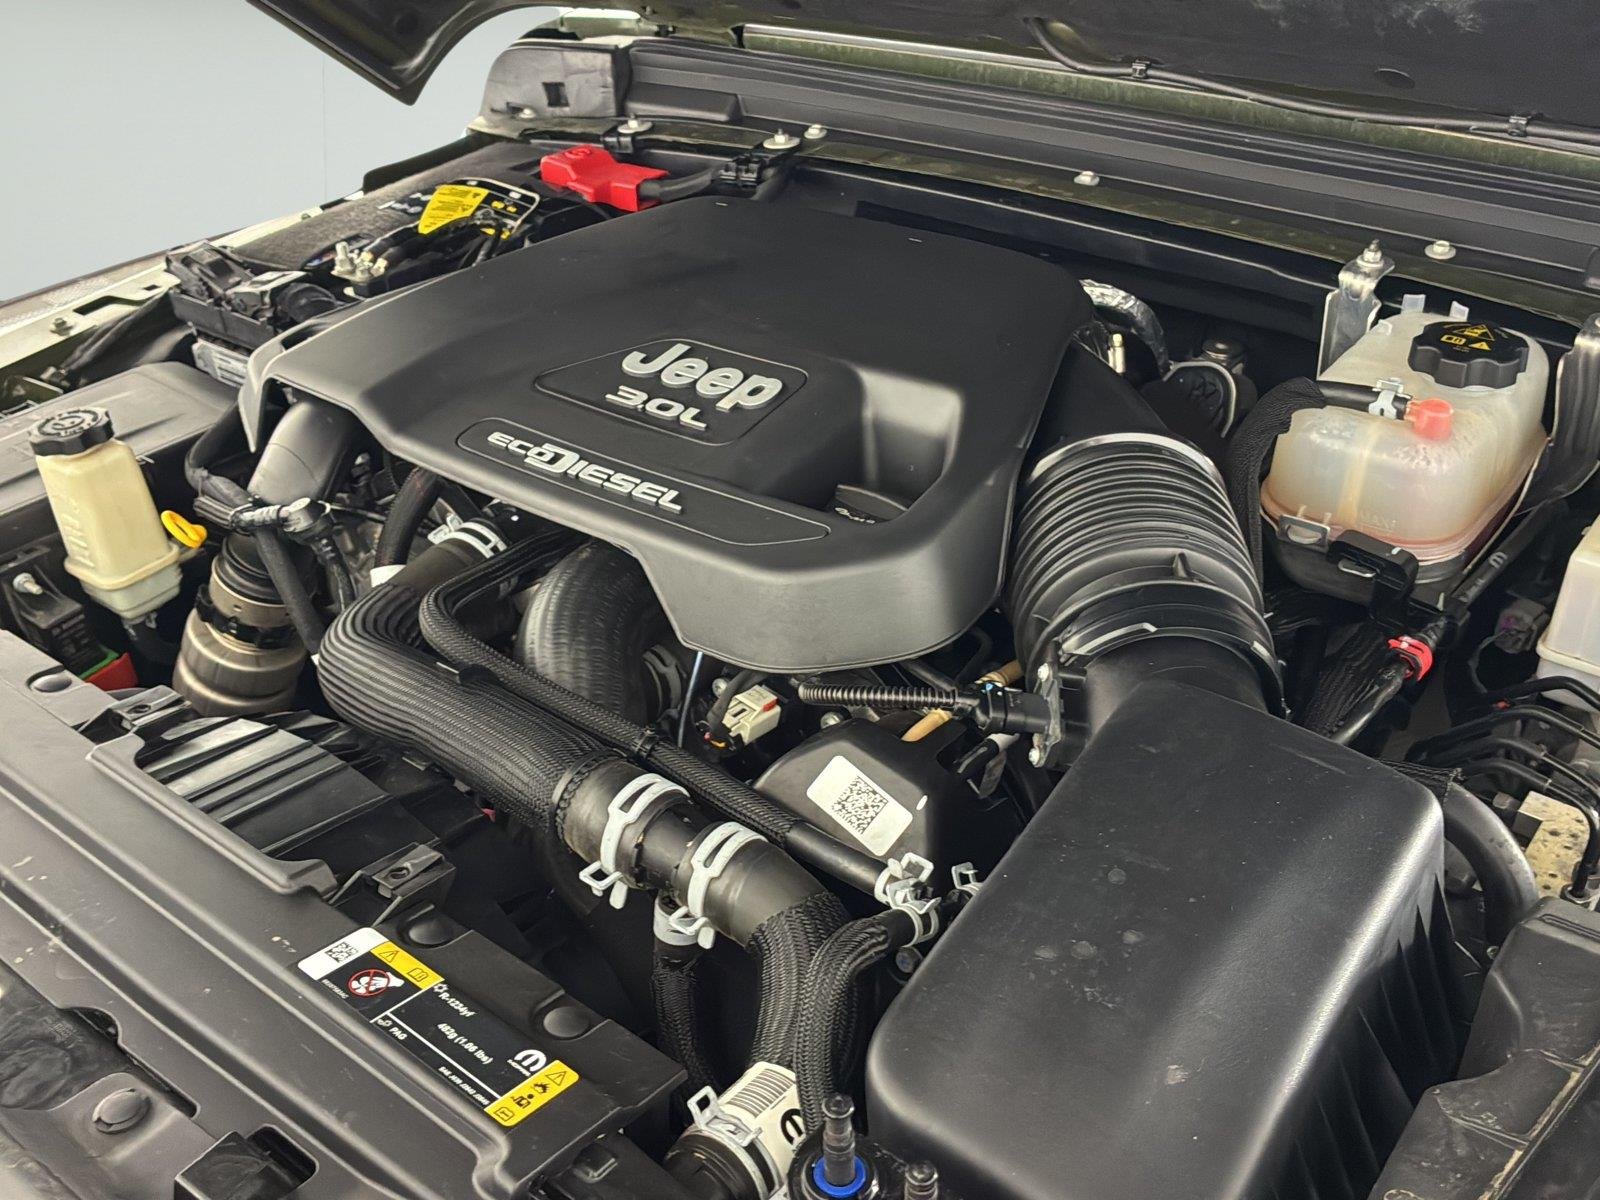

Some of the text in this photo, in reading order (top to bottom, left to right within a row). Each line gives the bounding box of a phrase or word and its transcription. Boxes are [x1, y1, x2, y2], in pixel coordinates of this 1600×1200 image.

[622, 343, 783, 413] Jeep
[605, 385, 708, 431] 3.0L
[438, 992, 477, 1017] R-1234yf
